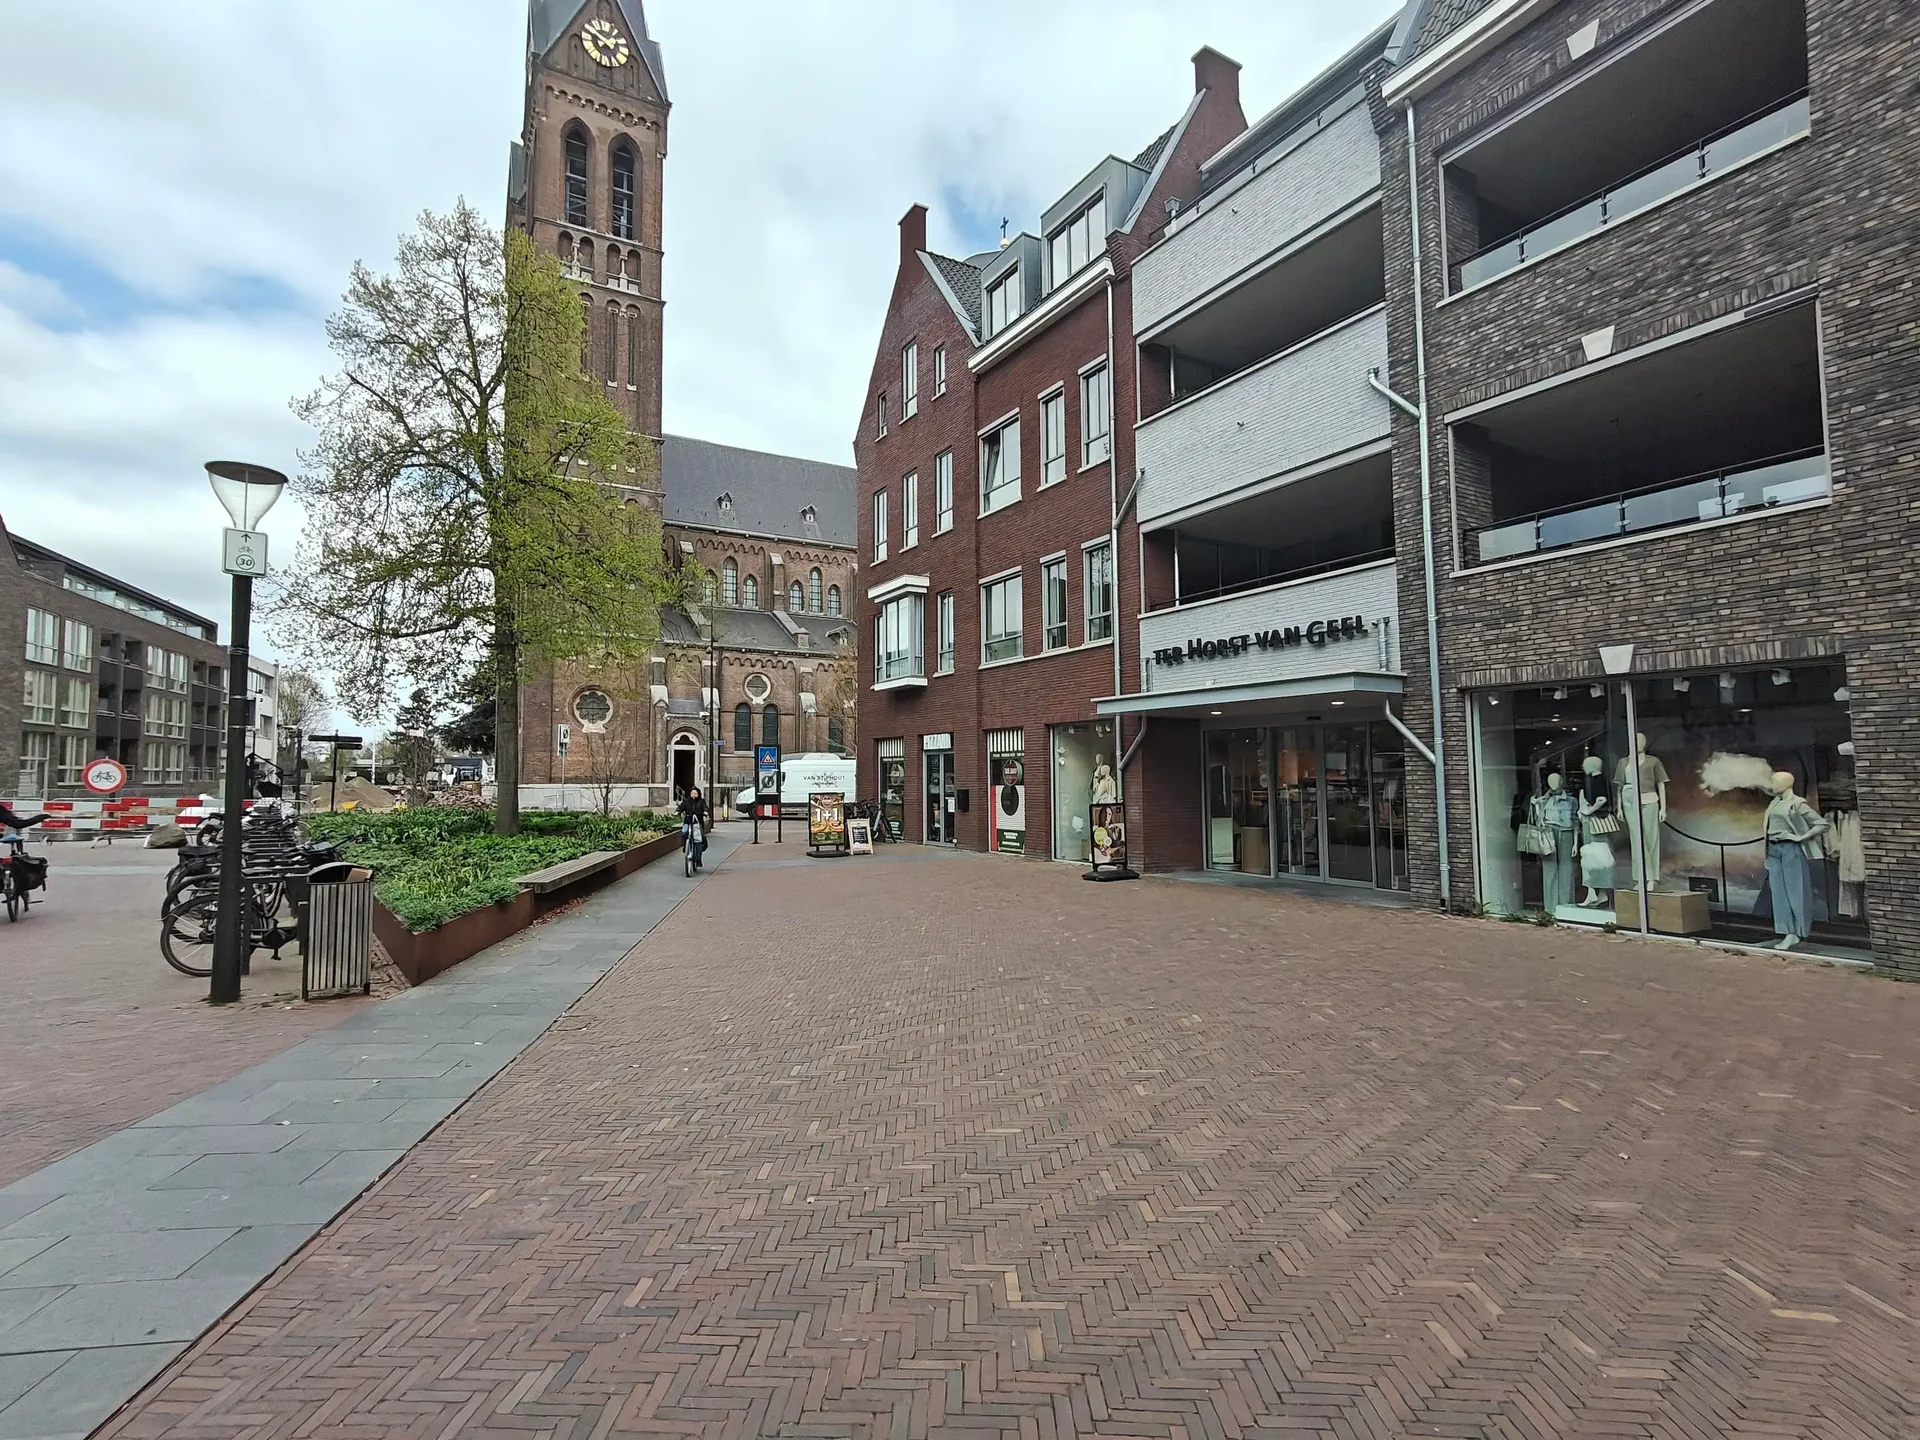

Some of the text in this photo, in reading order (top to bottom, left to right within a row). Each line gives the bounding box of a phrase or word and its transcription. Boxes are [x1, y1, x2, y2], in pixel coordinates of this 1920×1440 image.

[238, 557, 253, 567] 30
[1153, 614, 1369, 666] TER HORST VAN GEEL
[815, 807, 839, 823] 1+1
